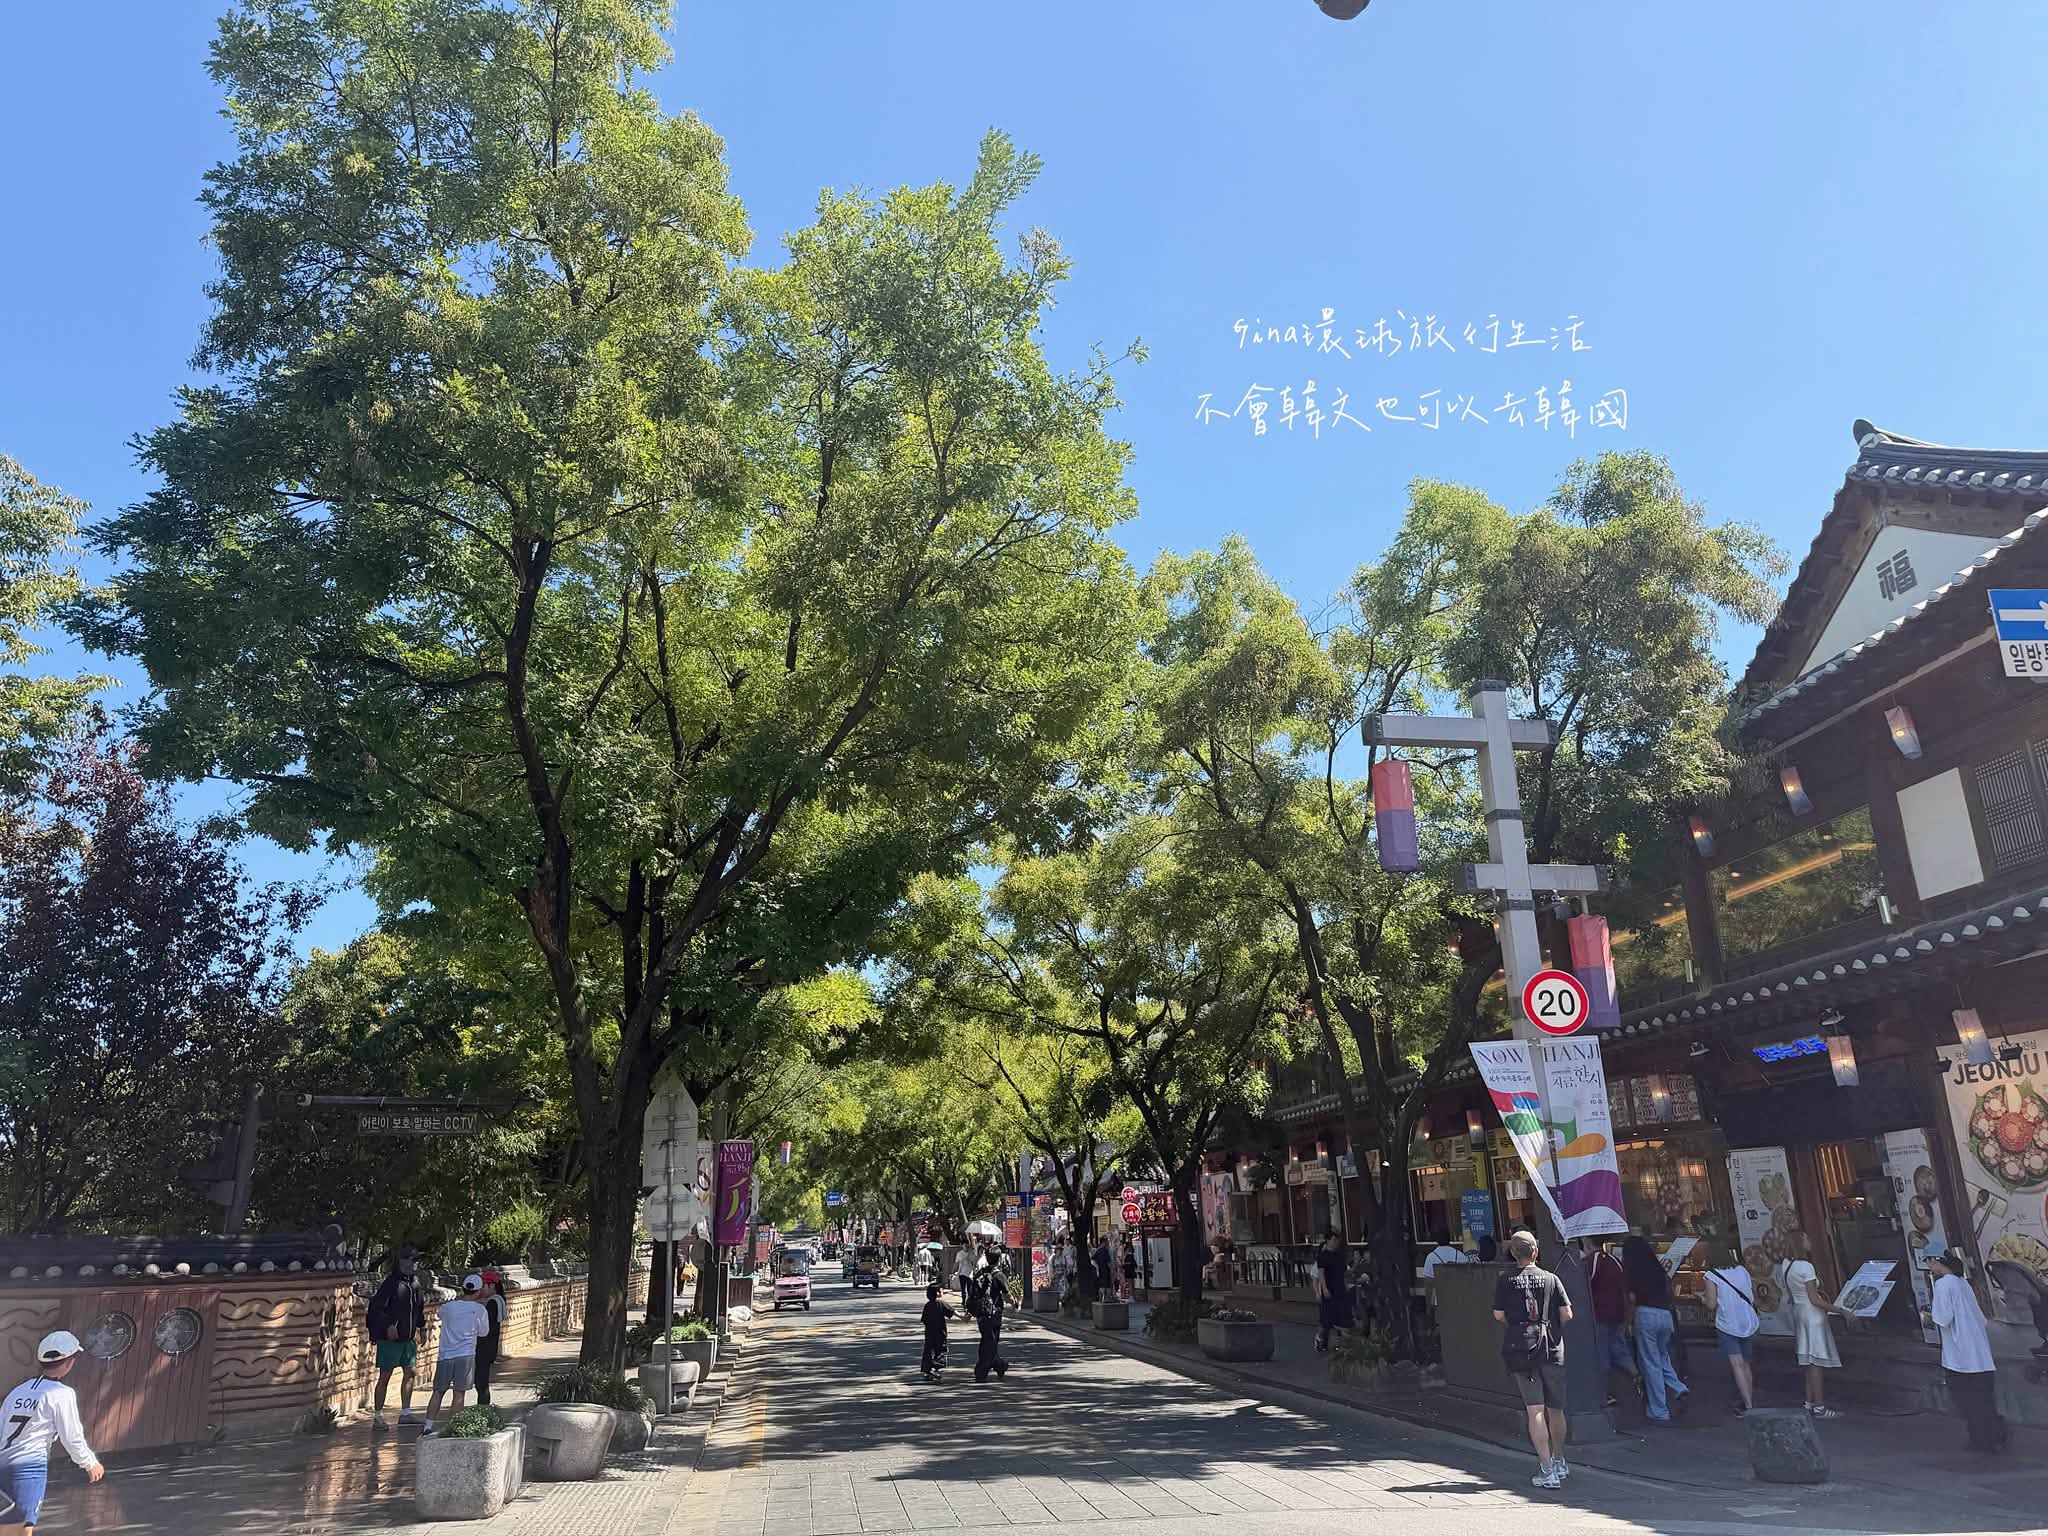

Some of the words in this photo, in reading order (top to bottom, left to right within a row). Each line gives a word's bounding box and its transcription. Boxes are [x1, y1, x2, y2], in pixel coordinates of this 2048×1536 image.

[1876, 549, 1918, 601] 福
[1538, 989, 1576, 1017] 20
[1477, 1046, 1525, 1065] NOW
[1543, 1043, 1601, 1063] HANJI
[1953, 1052, 2041, 1086] JEONJU
[362, 1116, 390, 1130] 어린이
[392, 1117, 411, 1129] 보호
[414, 1117, 440, 1130] 말하는
[444, 1116, 474, 1130] CCTV
[723, 1143, 748, 1153] NOW
[14, 1398, 39, 1411] SON
[4, 1414, 33, 1449] 7
